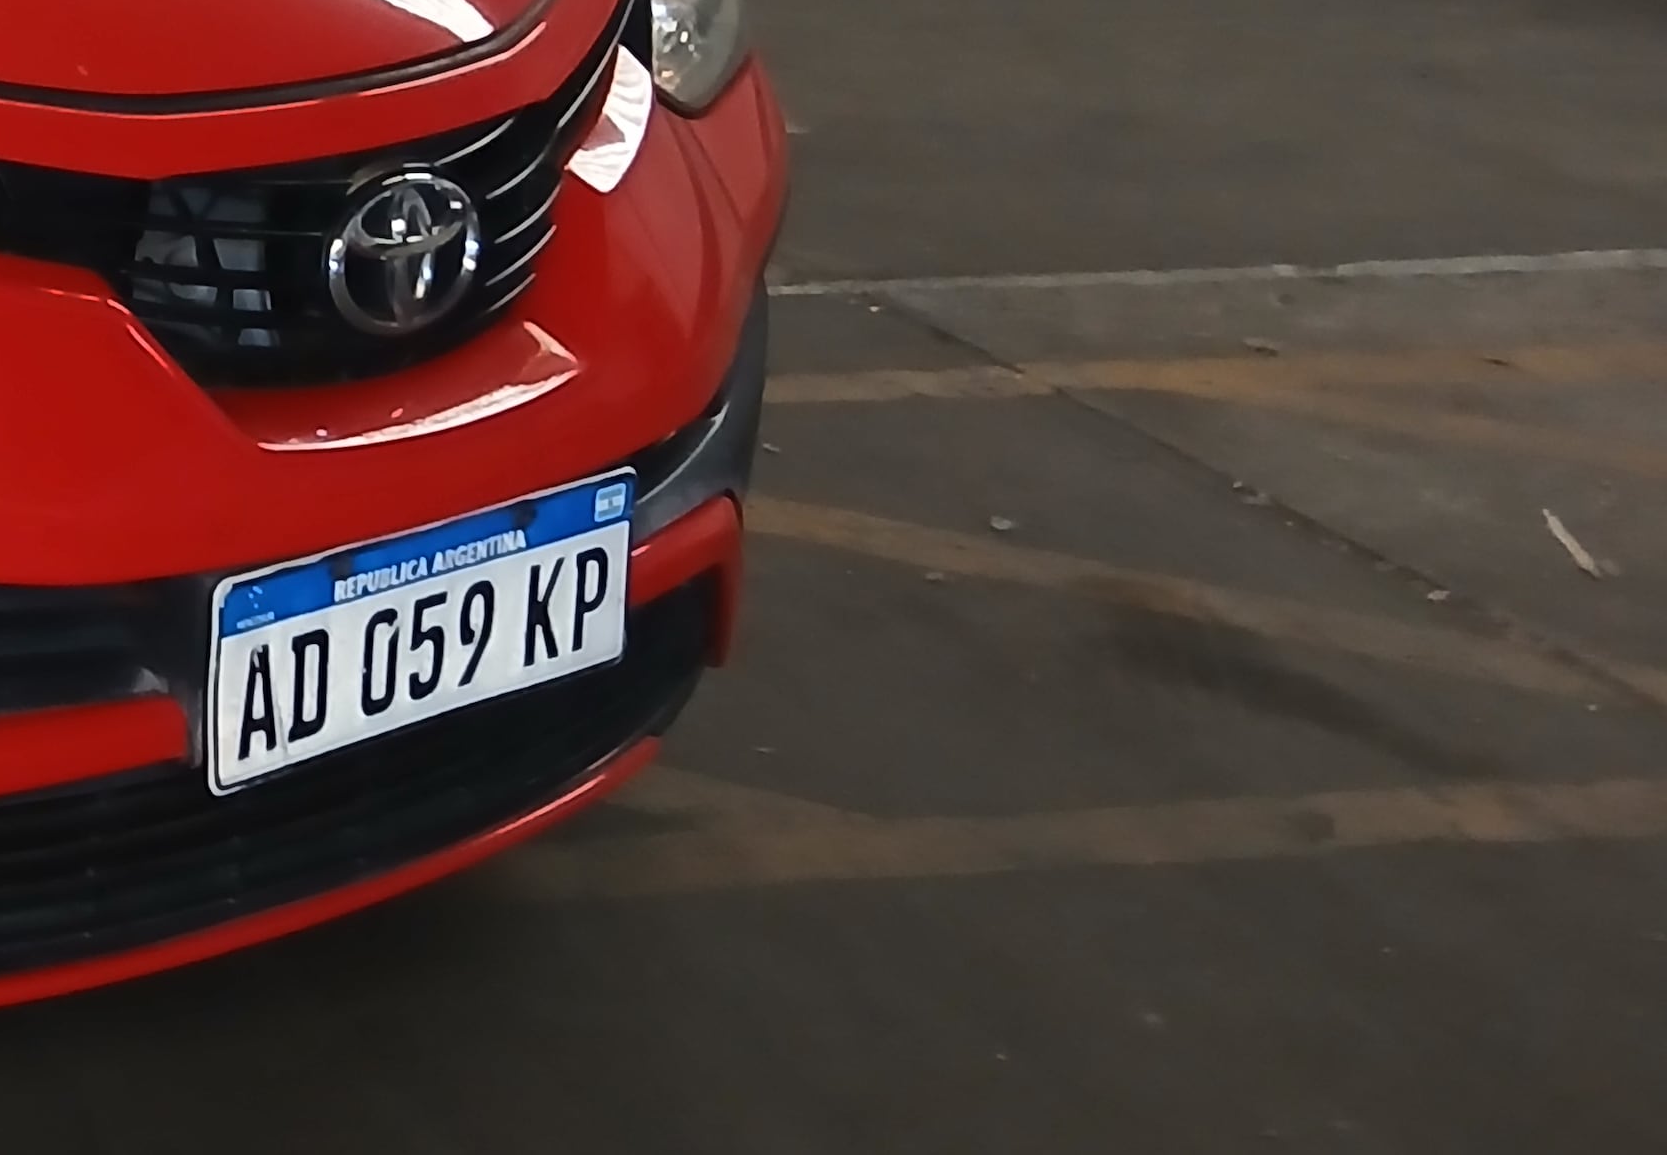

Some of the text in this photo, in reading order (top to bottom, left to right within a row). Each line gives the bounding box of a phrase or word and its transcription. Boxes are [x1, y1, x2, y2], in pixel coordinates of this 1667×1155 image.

[431, 529, 527, 574] ARGENTINA
[237, 546, 609, 761] AD 059 KP
